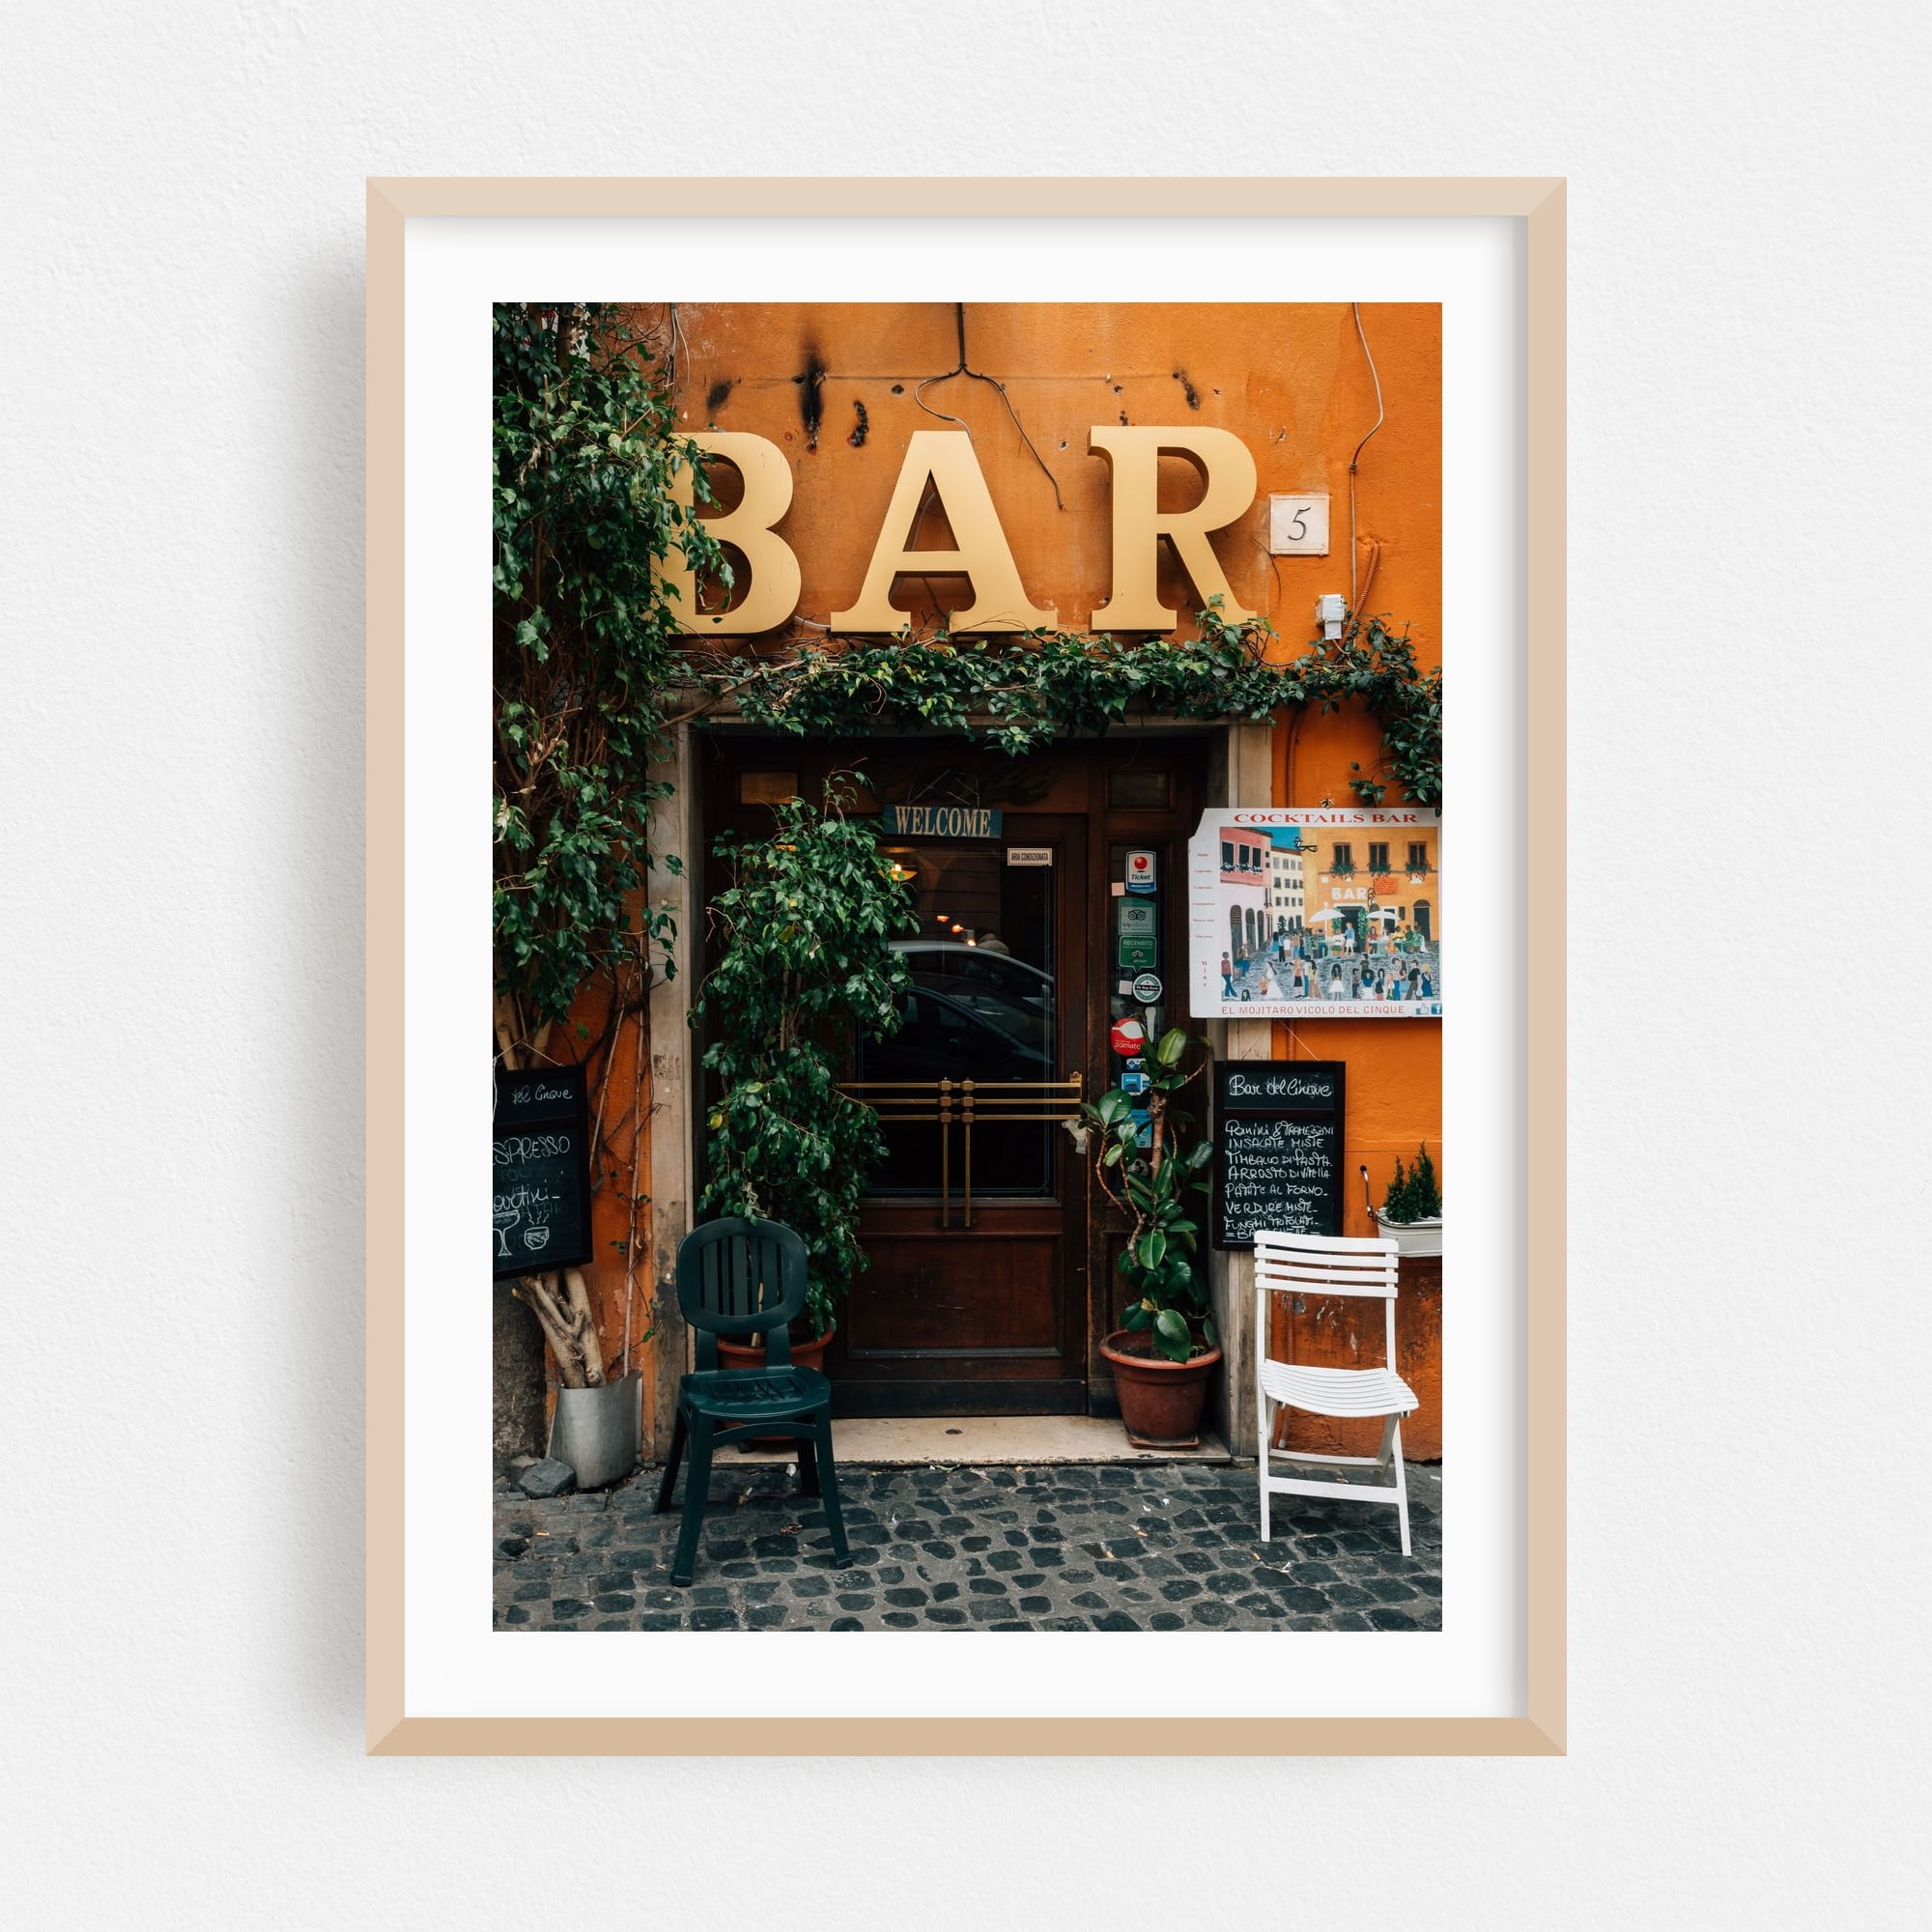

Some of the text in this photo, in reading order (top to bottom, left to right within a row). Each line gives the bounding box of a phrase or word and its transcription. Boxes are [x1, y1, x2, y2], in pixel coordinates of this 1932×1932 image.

[644, 426, 1258, 635] BAR
[1287, 506, 1312, 541] 5
[895, 806, 991, 838] WELCOME
[1234, 814, 1418, 823] COCKTAILS BAR
[1332, 888, 1367, 899] BAR
[1221, 1006, 1405, 1014] EL MOJITARO VICOLO DEL CINQUE
[1229, 1074, 1264, 1095] Bar
[1266, 1075, 1286, 1095] del
[1225, 1120, 1269, 1136] Panini
[1229, 1134, 1324, 1149] INSALATE MISTE
[493, 1135, 571, 1165] SPRESSO
[1229, 1166, 1287, 1179] ARROSTO
[1269, 1183, 1283, 1195] AL
[1225, 1201, 1283, 1214] VERDURE
[1223, 1216, 1266, 1231] FUNGHI
